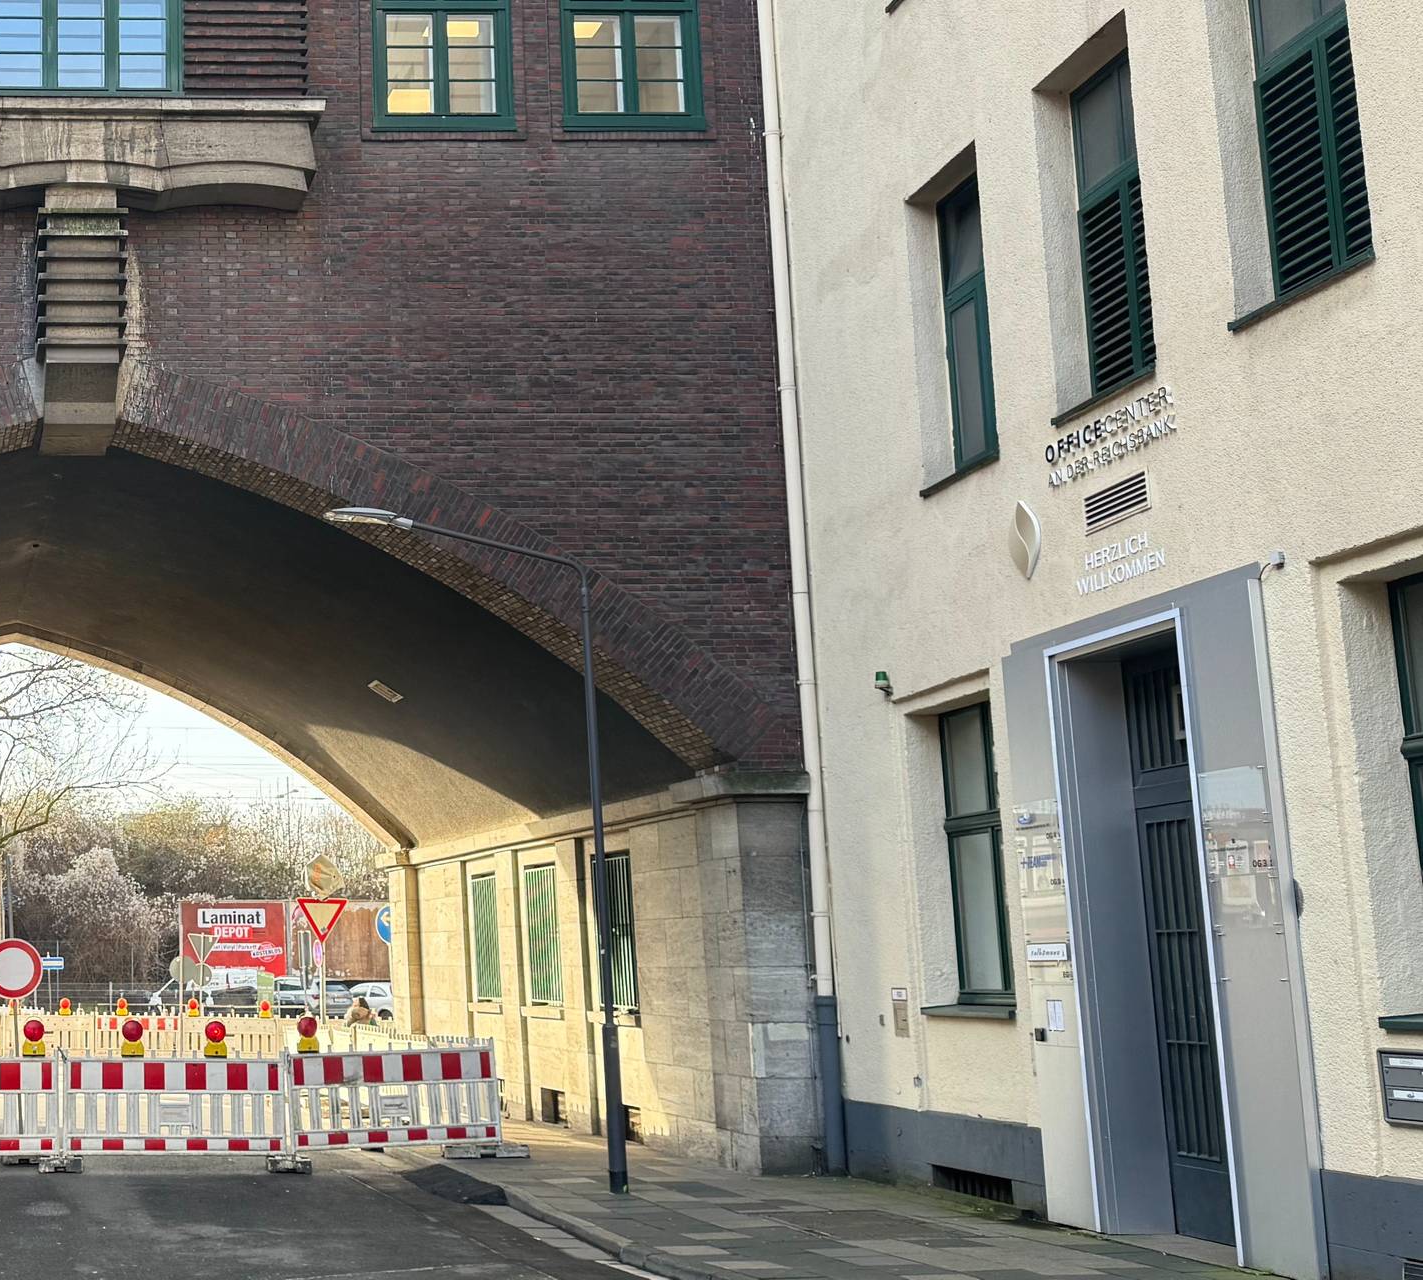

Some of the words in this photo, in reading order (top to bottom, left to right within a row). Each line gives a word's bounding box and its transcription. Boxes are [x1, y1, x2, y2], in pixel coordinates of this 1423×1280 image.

[1045, 386, 1173, 463] OFFICECENTER
[1048, 468, 1065, 488] AN
[1066, 456, 1093, 479] DER
[1093, 415, 1175, 466] REICHSBANK
[1076, 547, 1166, 596] WILLKOMMEN
[1084, 531, 1149, 571] HERZLICH
[202, 910, 262, 924] Laminat
[214, 926, 251, 938] DEPOT
